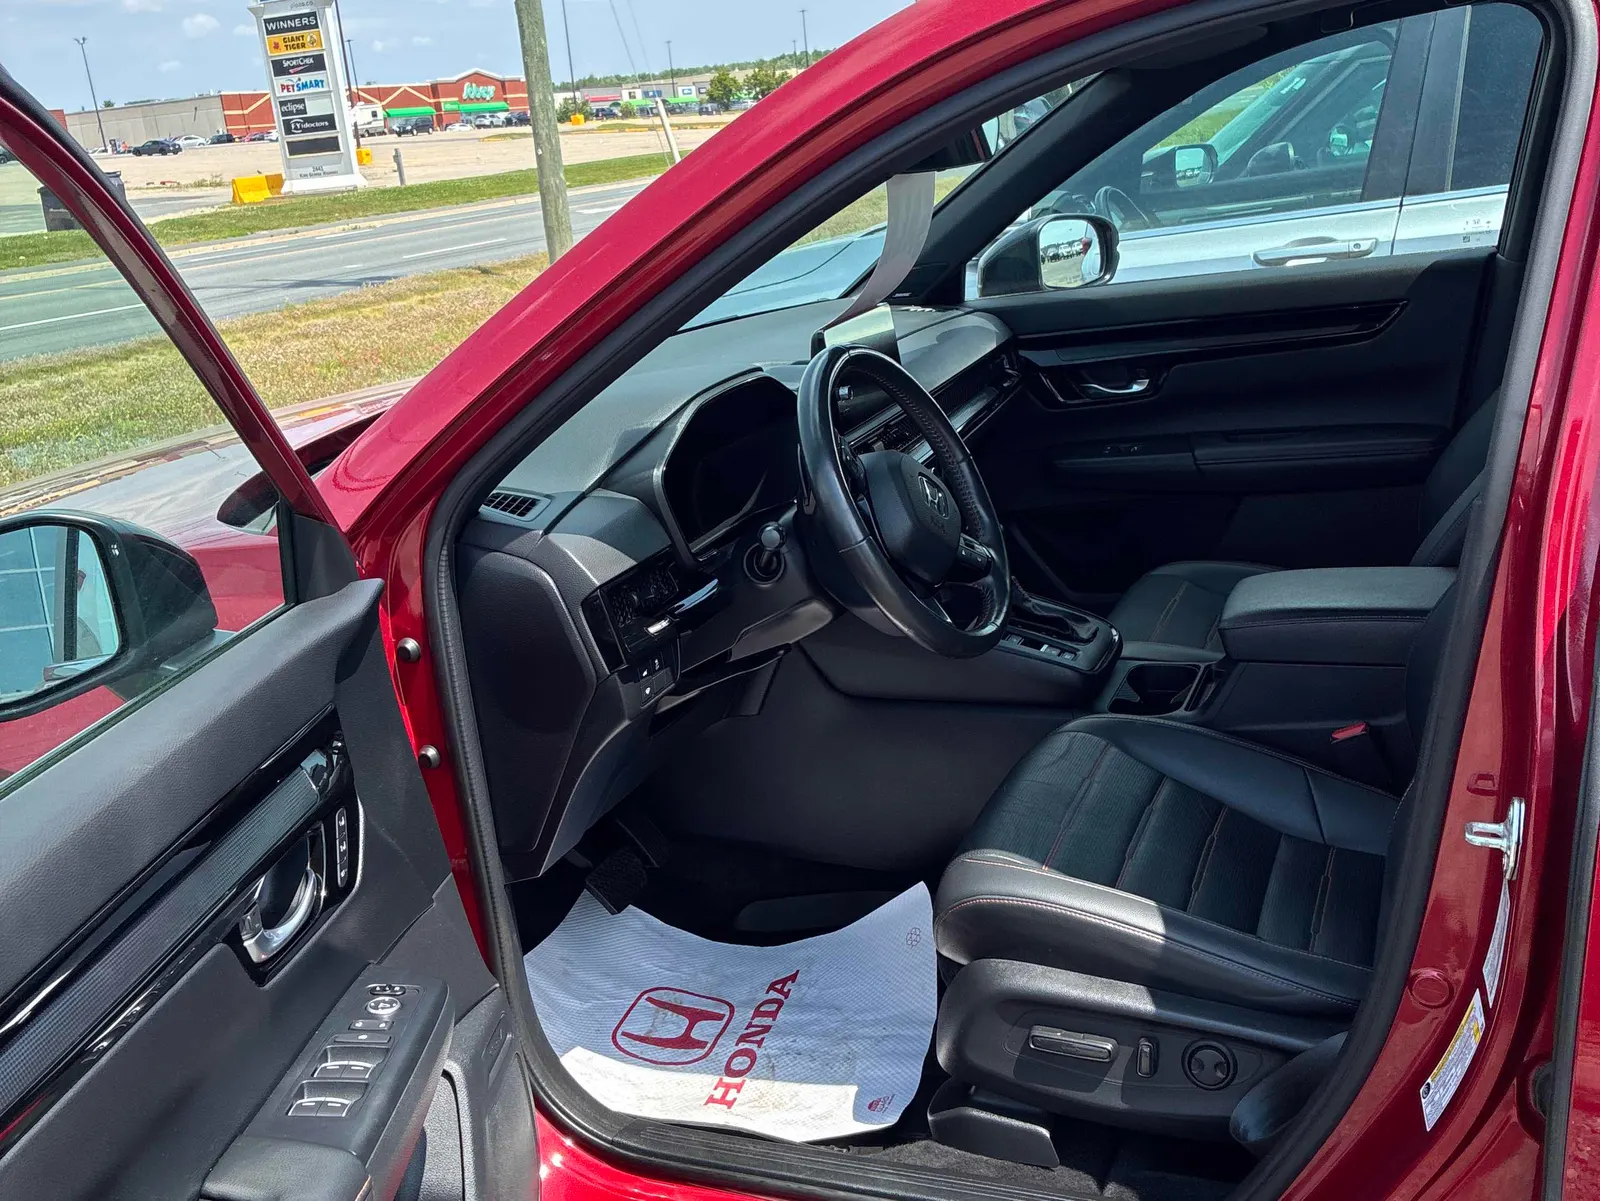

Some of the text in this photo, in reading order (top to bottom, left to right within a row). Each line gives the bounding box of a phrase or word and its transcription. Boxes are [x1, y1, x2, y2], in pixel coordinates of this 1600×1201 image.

[266, 16, 317, 31] WINNERS
[282, 35, 305, 44] GIANT
[283, 42, 306, 51] TIGER
[281, 102, 305, 114] eclipse
[703, 969, 800, 1110] HONDA
